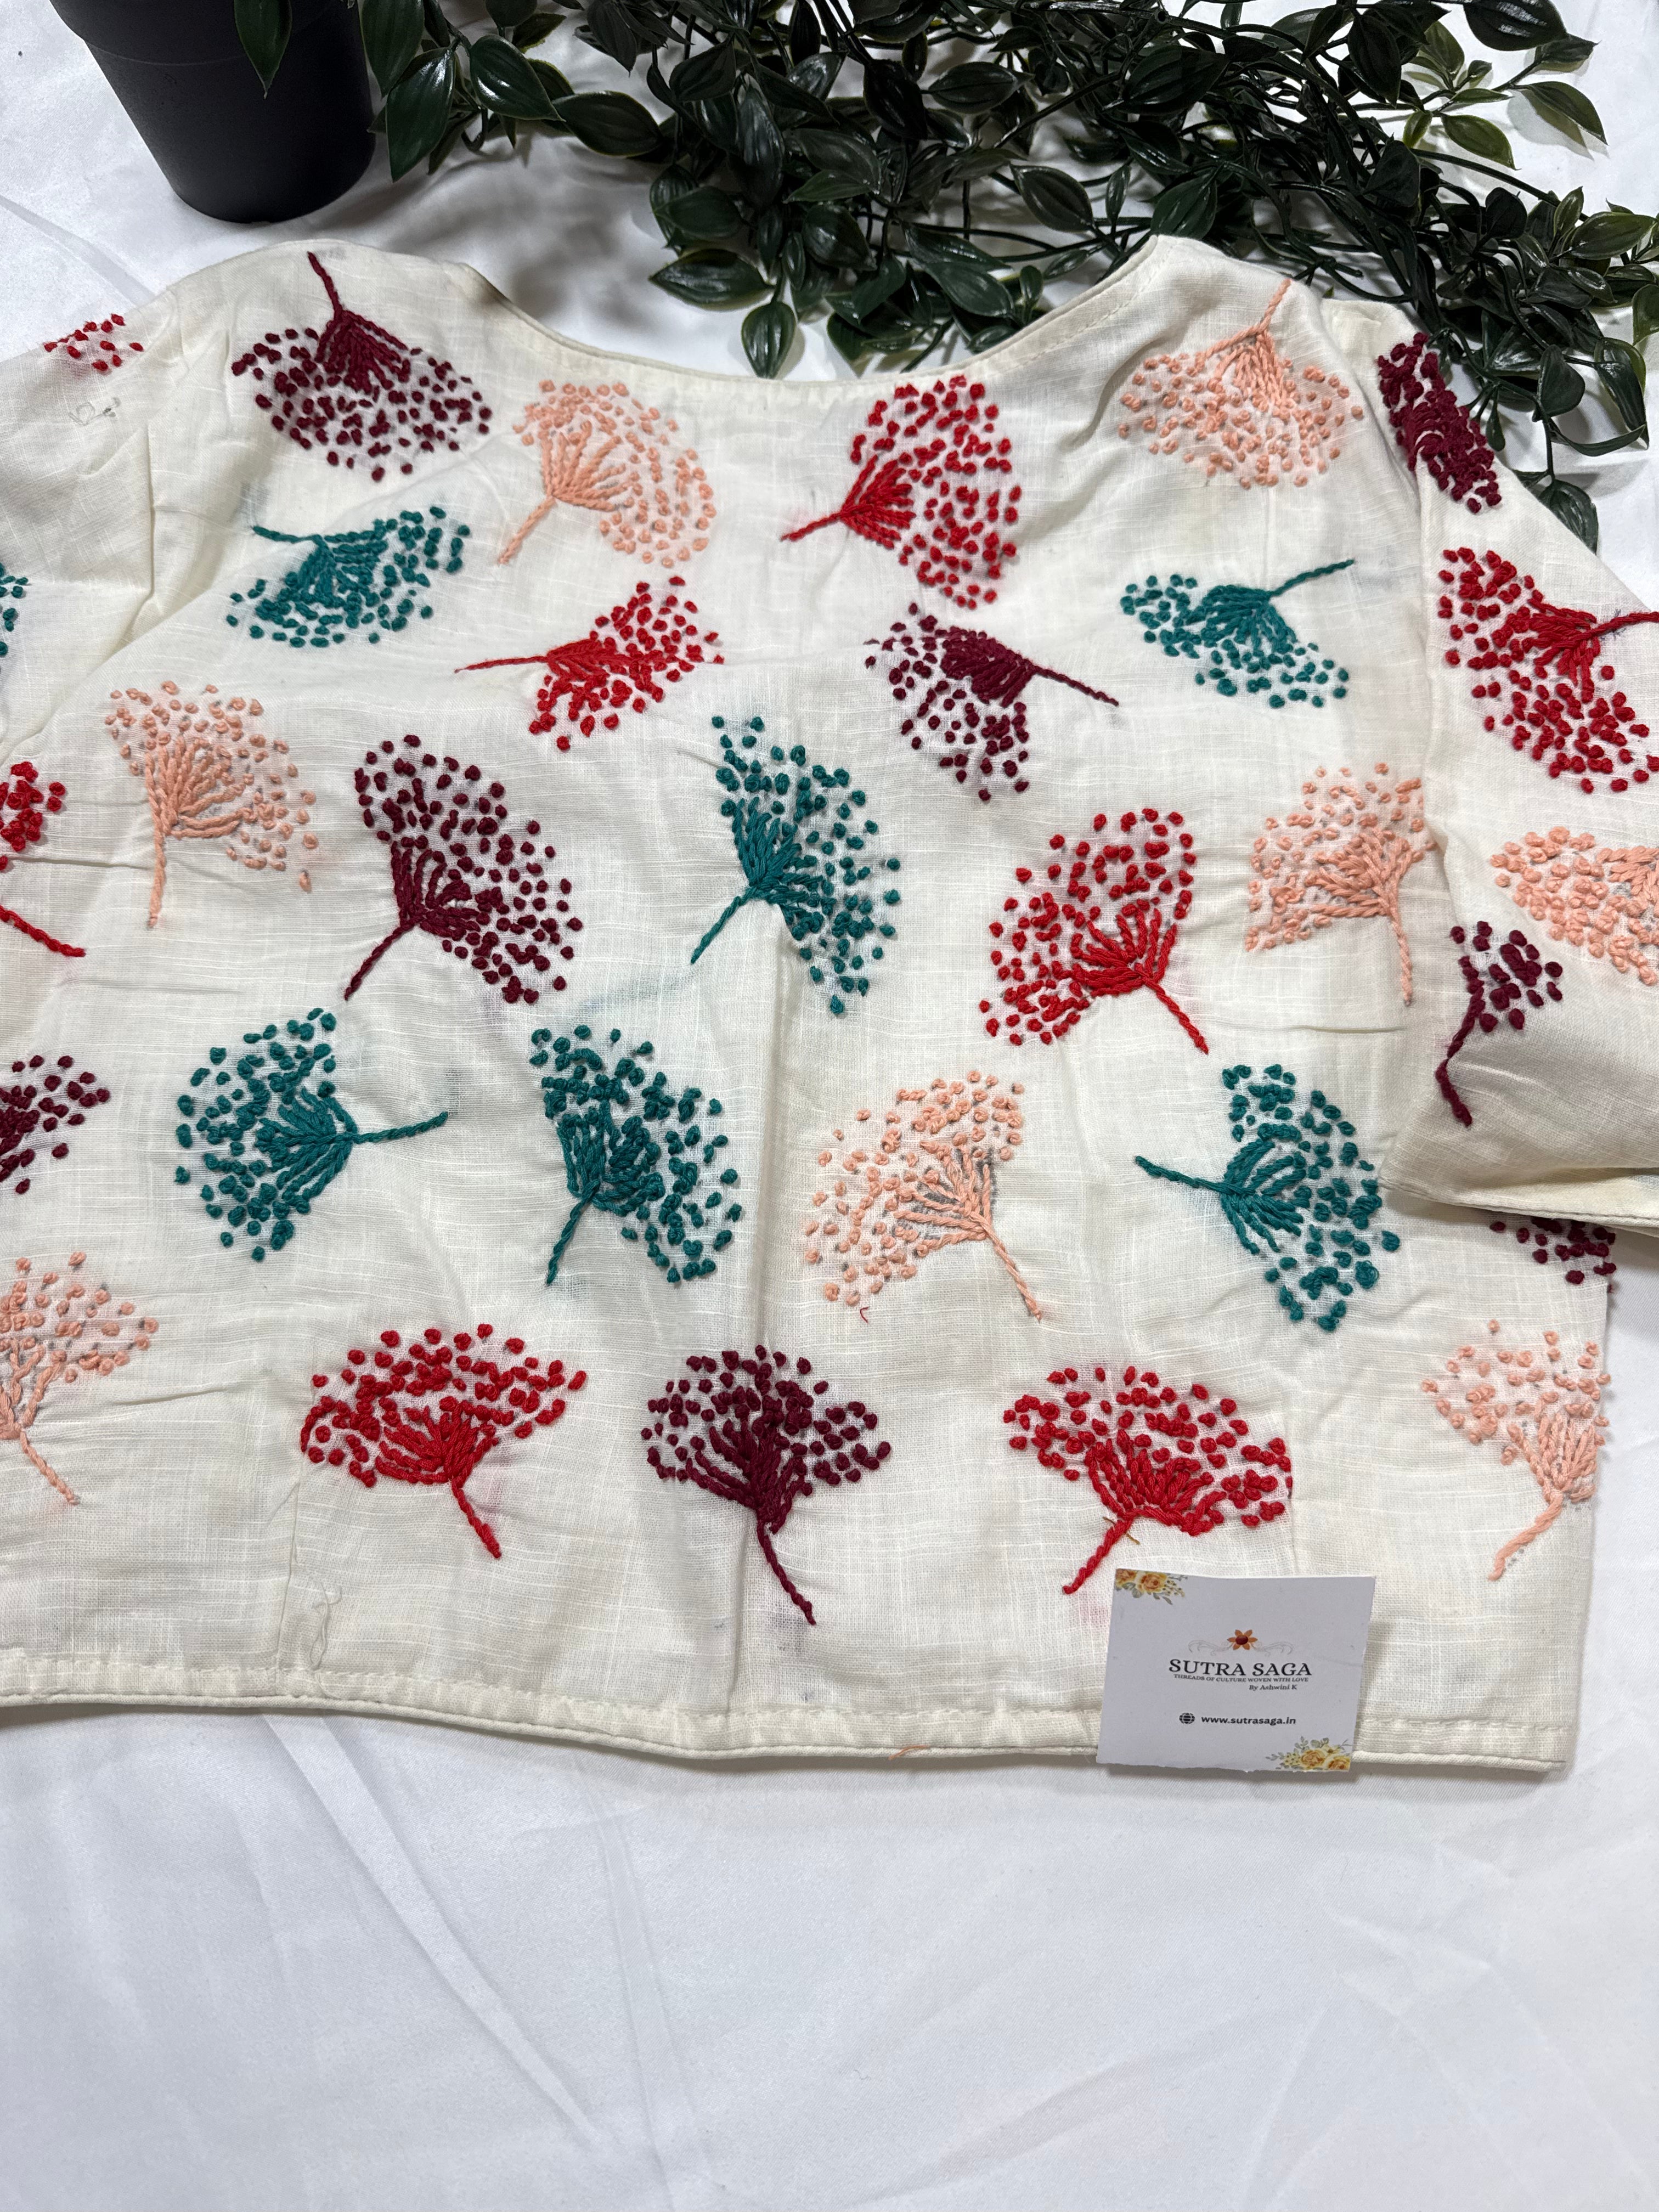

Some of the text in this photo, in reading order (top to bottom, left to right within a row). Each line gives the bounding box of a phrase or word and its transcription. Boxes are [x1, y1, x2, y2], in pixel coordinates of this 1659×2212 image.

[1169, 1659, 1312, 1677] SUTRA SAGA
[1201, 1716, 1296, 1726] www.sutrasaga.in
